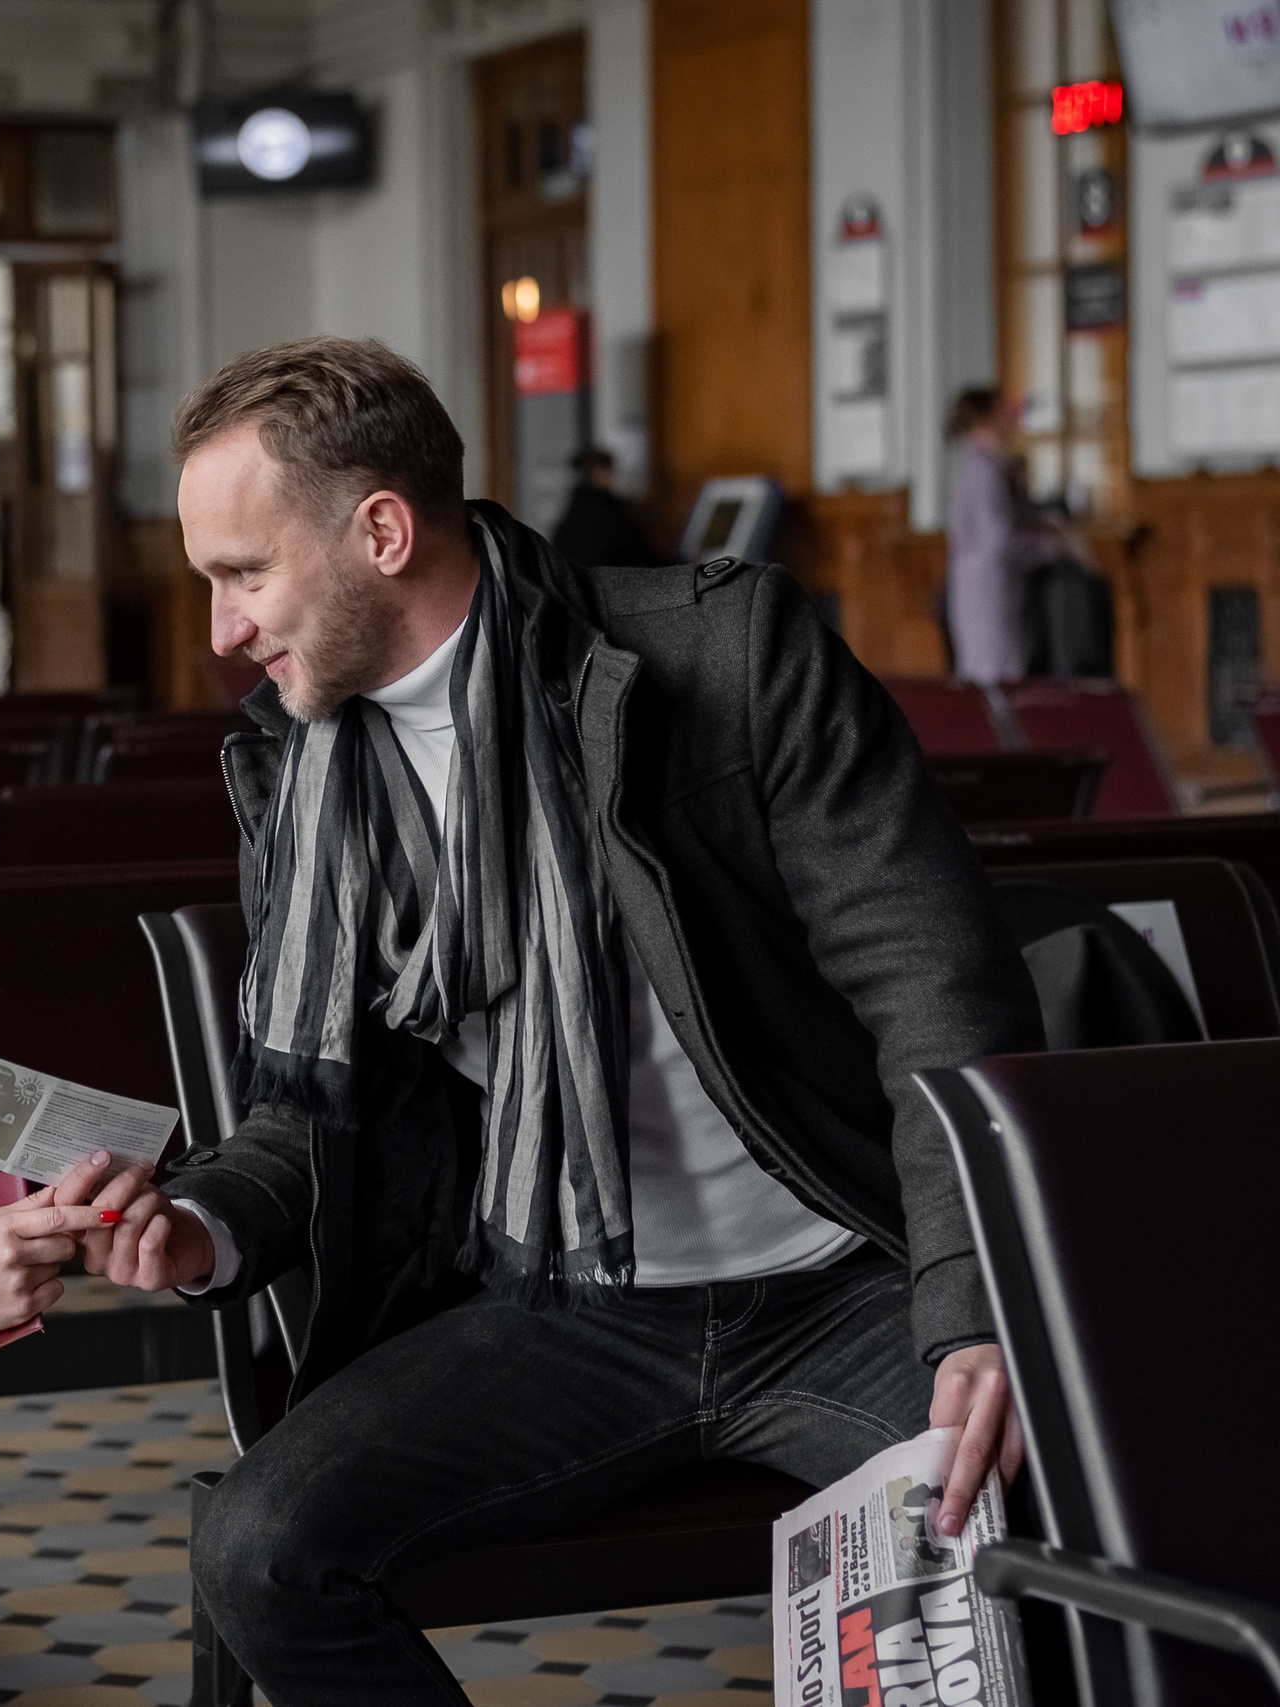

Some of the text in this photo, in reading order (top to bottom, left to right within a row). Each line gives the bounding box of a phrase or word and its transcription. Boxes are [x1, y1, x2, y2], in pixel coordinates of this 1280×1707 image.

[840, 1546, 848, 1557] al
[850, 1521, 859, 1596] e al Bayern
[859, 1505, 868, 1559] Chelsea
[841, 1561, 849, 1602] Dietro
[796, 1589, 826, 1707] lo Sport
[919, 1577, 984, 1707] OVA
